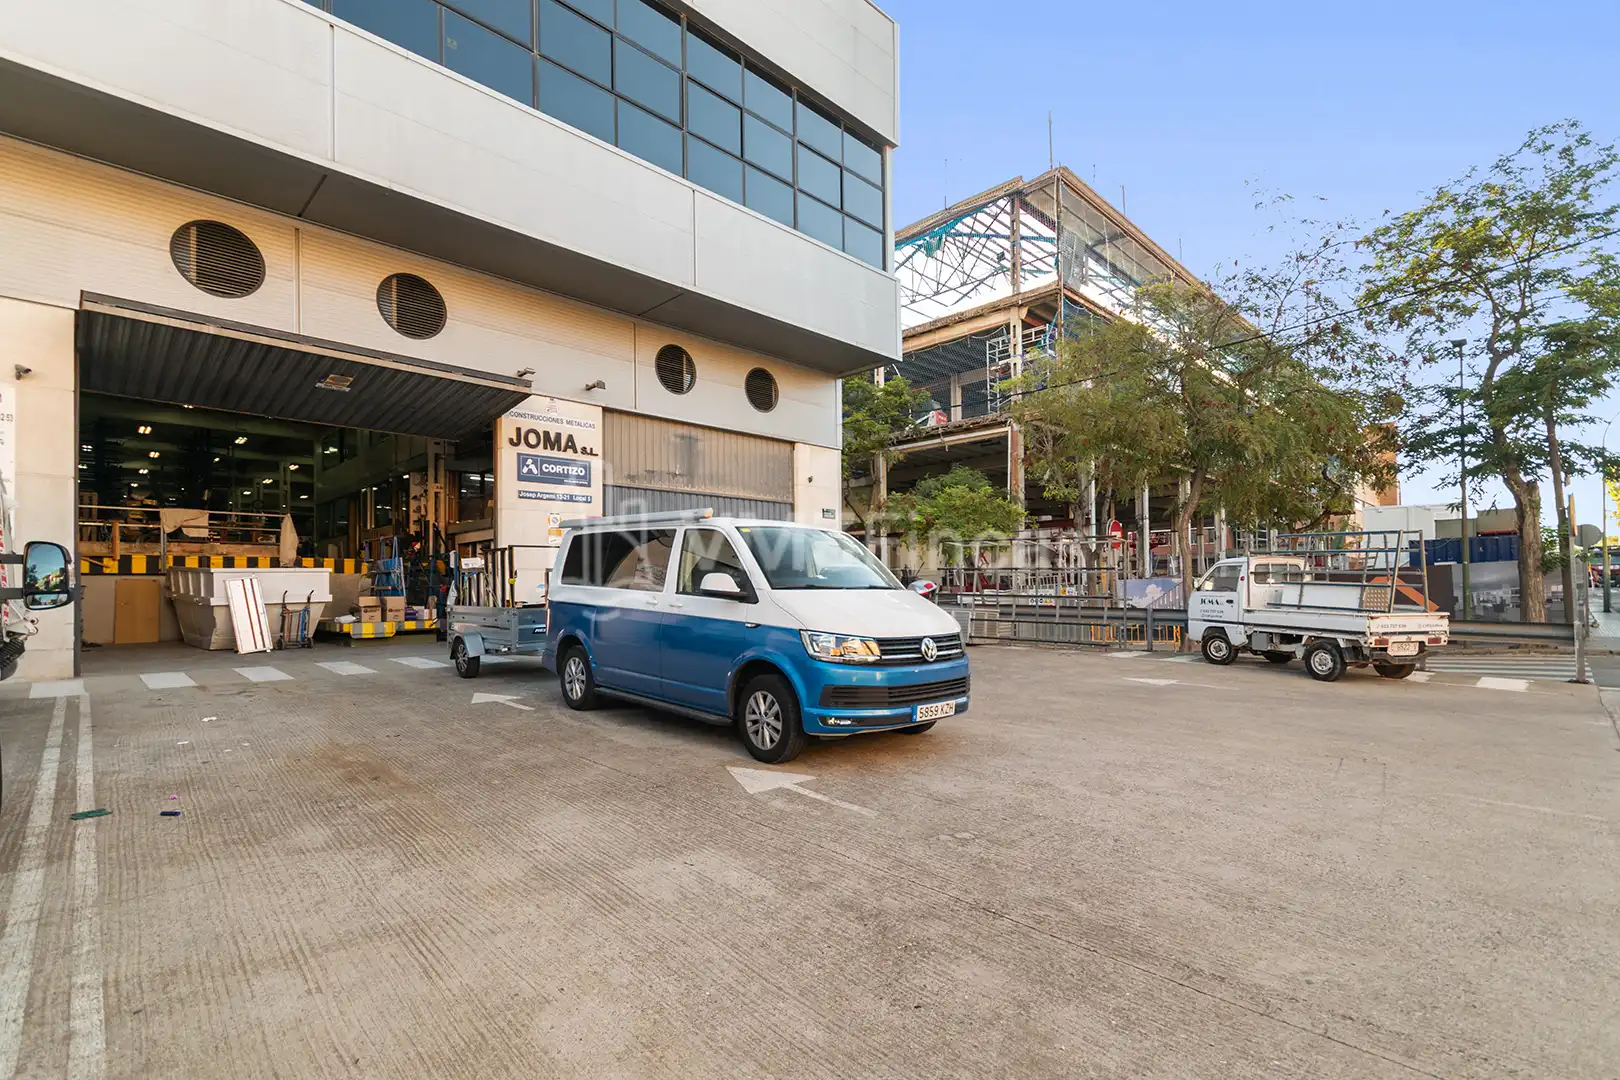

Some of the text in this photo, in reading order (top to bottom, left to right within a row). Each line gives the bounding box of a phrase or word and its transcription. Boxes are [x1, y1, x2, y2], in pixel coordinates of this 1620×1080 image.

[509, 411, 564, 425] CONSTRUCCIONES
[508, 427, 578, 454] JOMA
[542, 463, 585, 476] CORTIZO
[520, 490, 536, 499] Josep
[919, 705, 939, 719] 5859
